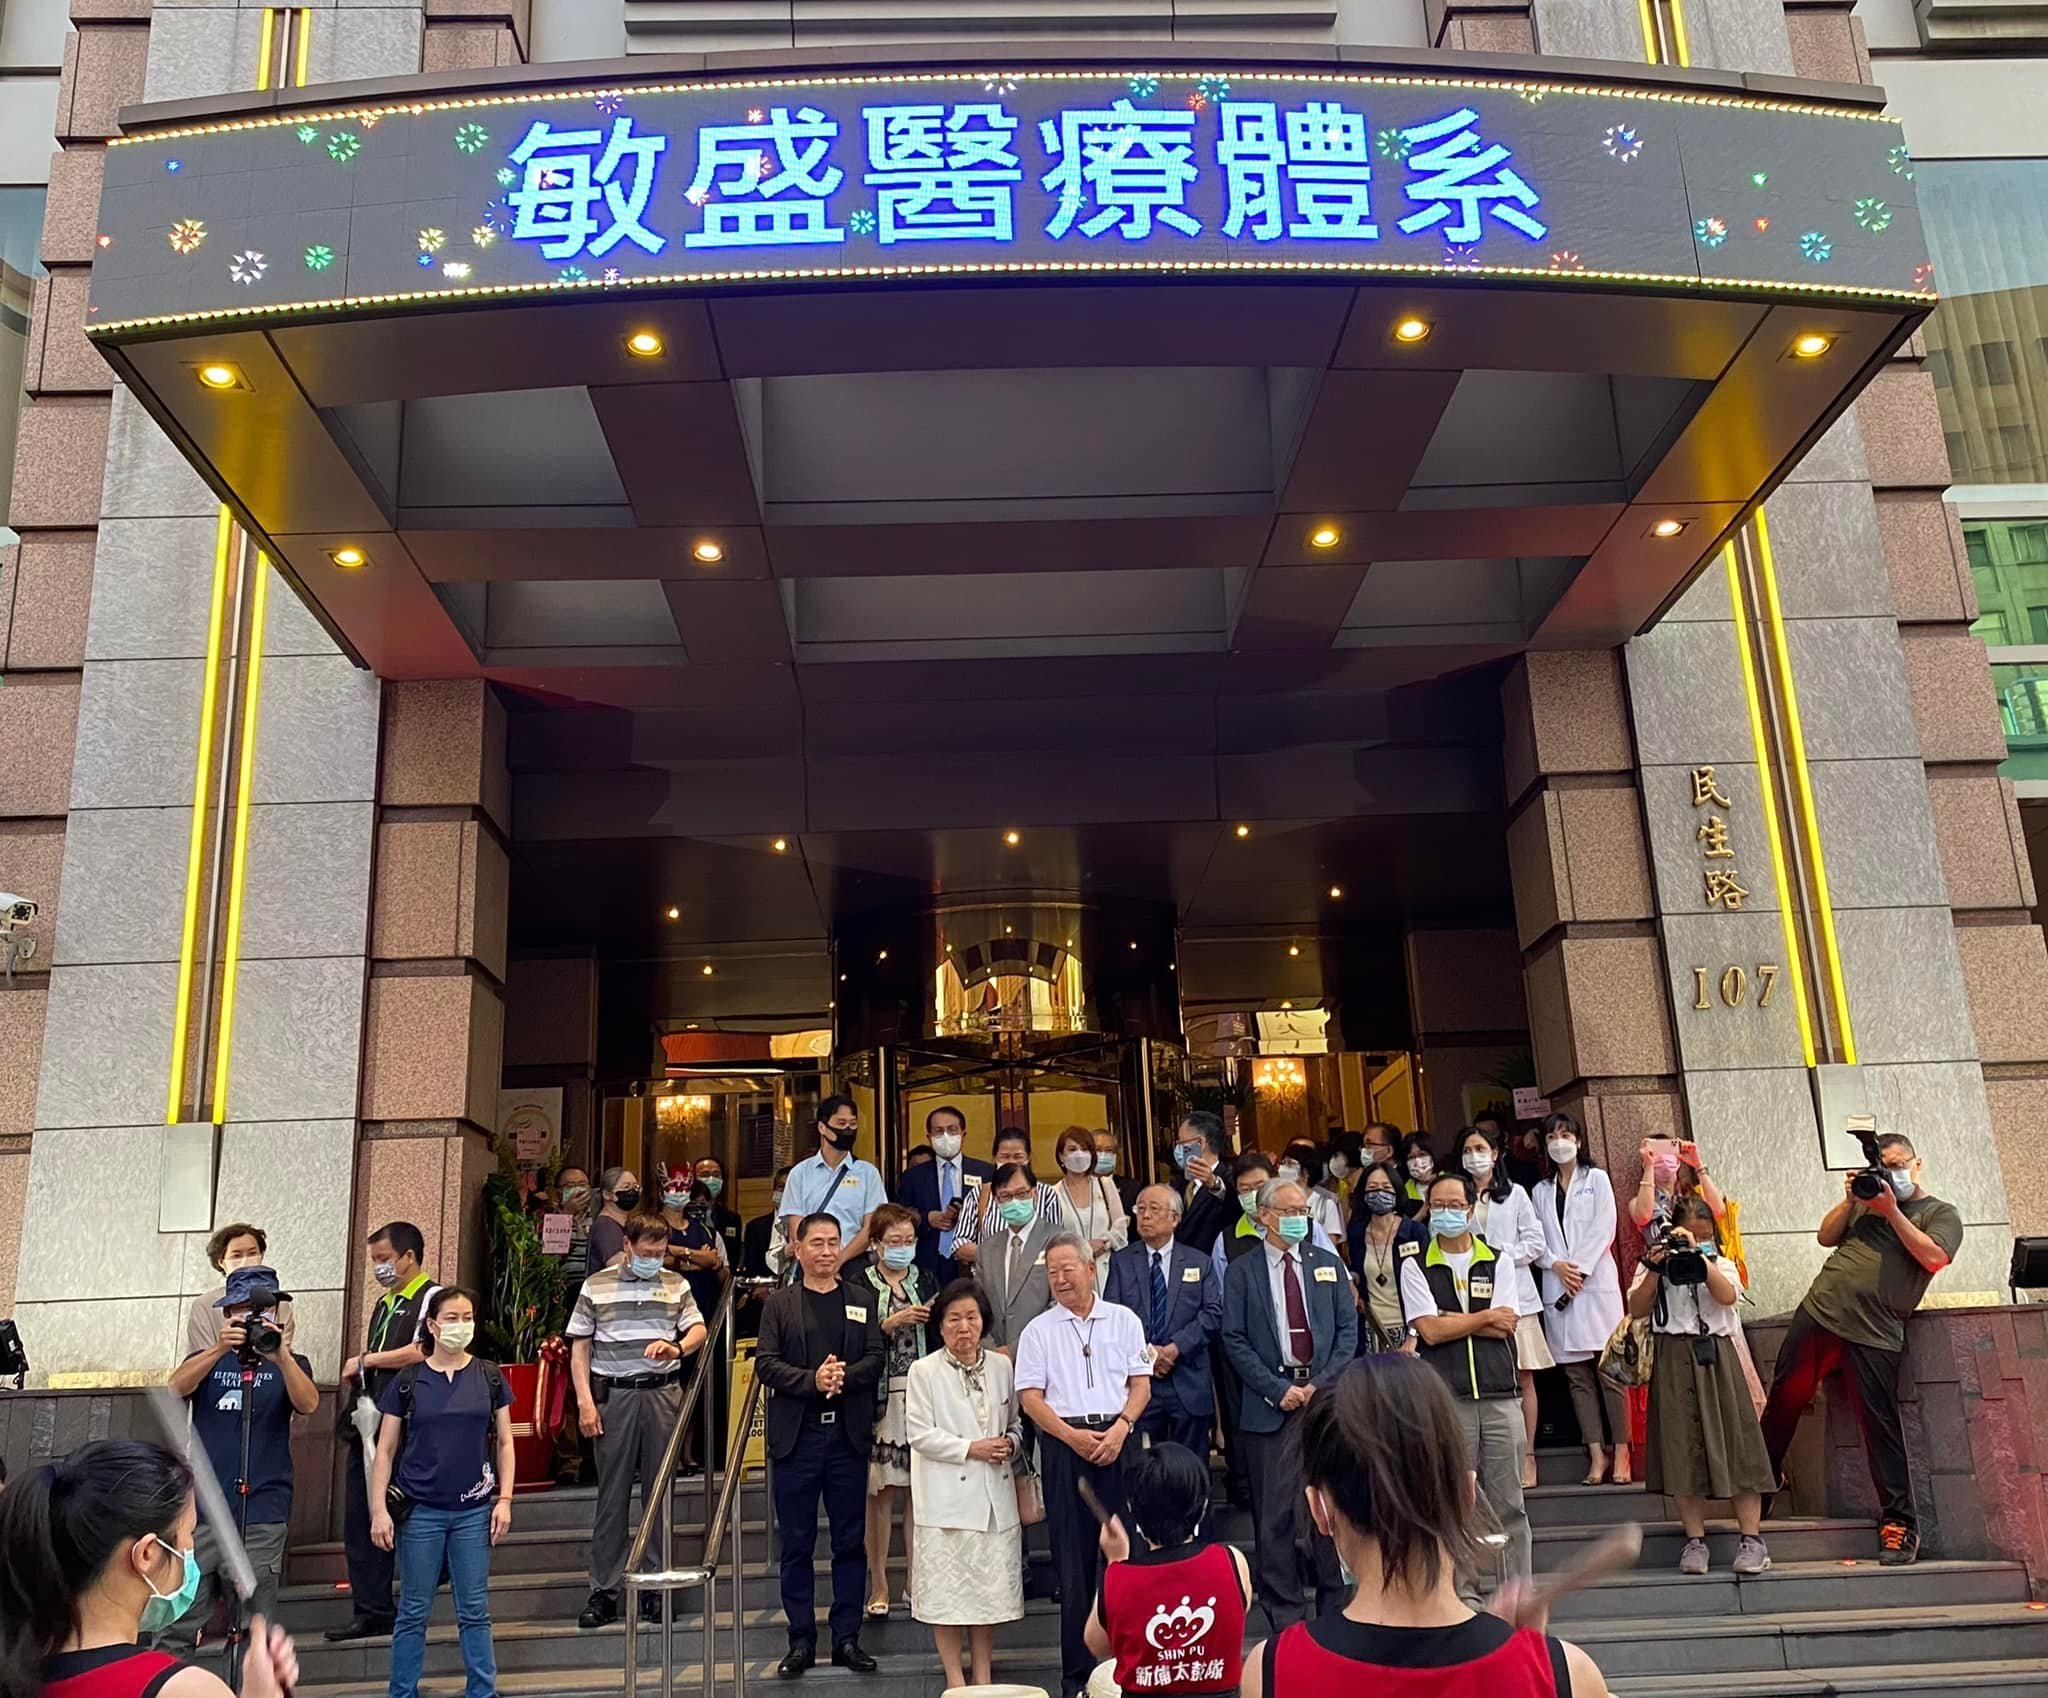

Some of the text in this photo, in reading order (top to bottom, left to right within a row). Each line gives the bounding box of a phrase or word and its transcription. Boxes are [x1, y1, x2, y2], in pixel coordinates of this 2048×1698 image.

[508, 99, 1547, 260] 敏盛醫療體系
[1691, 765, 1749, 910] 民生路
[1693, 966, 1779, 1009] 107
[214, 1371, 247, 1380] ELEPHA
[220, 1379, 262, 1388] MATR
[1157, 1645, 1205, 1660] SHIN PU
